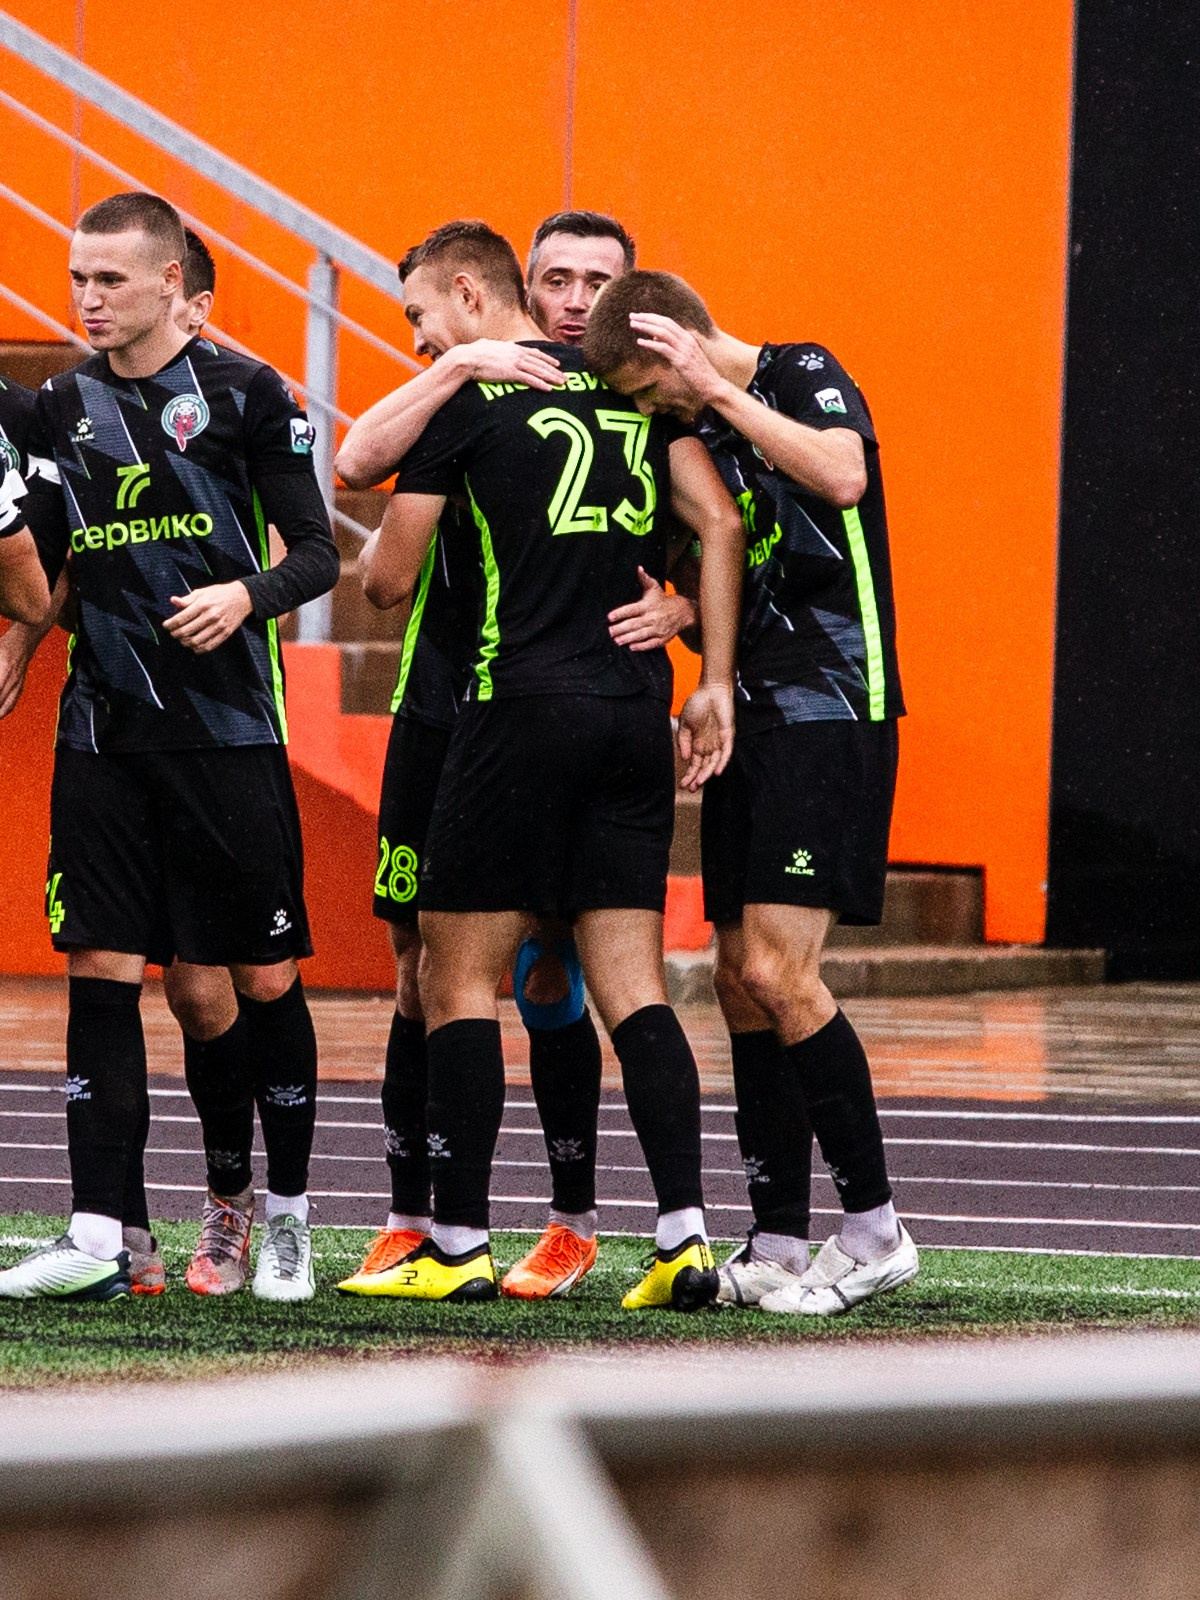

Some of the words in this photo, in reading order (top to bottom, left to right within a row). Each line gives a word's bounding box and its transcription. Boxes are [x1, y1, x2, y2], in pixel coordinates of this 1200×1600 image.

[527, 405, 656, 537] 23
[374, 835, 418, 903] 28
[784, 866, 816, 876] KELME
